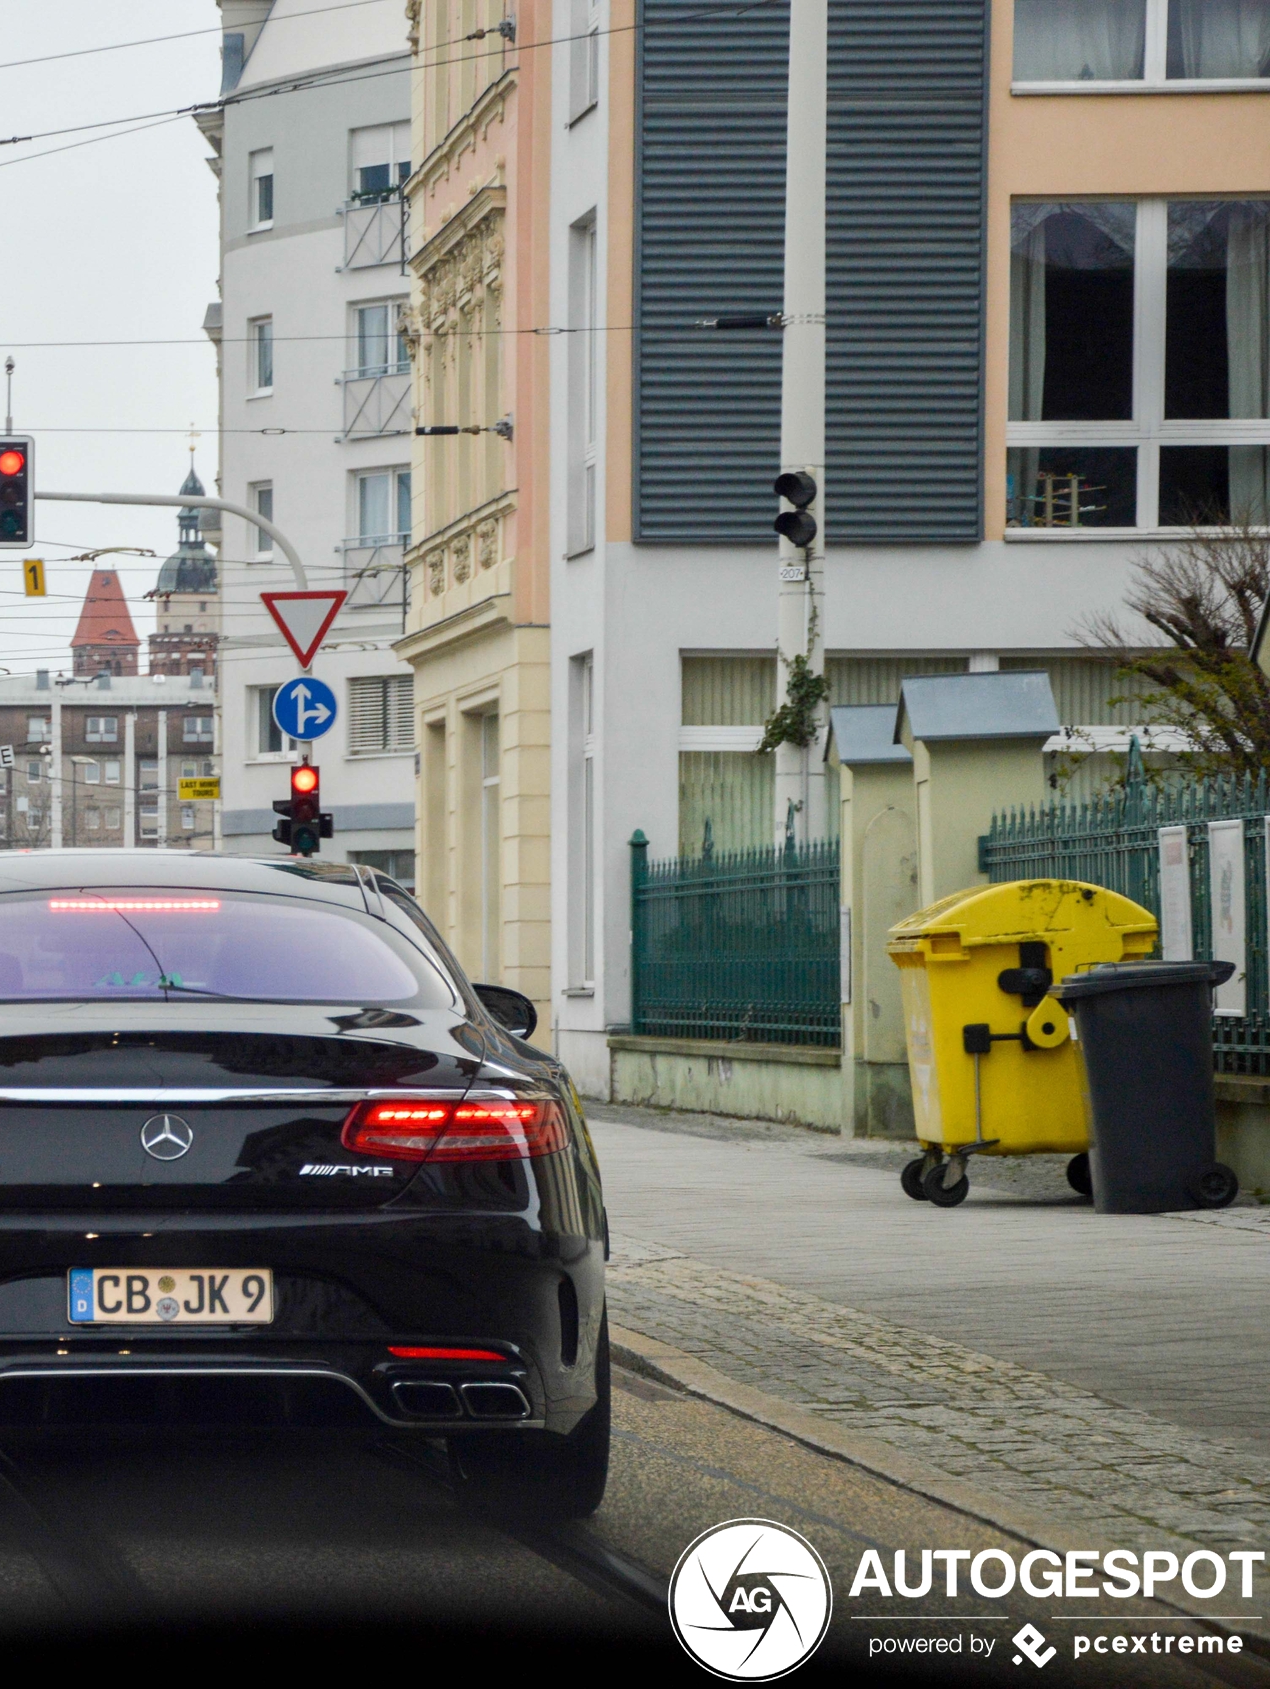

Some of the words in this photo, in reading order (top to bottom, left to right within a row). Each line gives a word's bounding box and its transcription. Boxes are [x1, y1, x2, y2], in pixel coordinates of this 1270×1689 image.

[28, 565, 39, 590] 1
[782, 568, 800, 579] 207
[1, 748, 12, 764] E
[328, 1165, 394, 1177] AMG
[77, 1300, 87, 1312] D
[97, 1275, 151, 1314] CB
[184, 1275, 230, 1314] JK
[242, 1275, 265, 1313] 9
